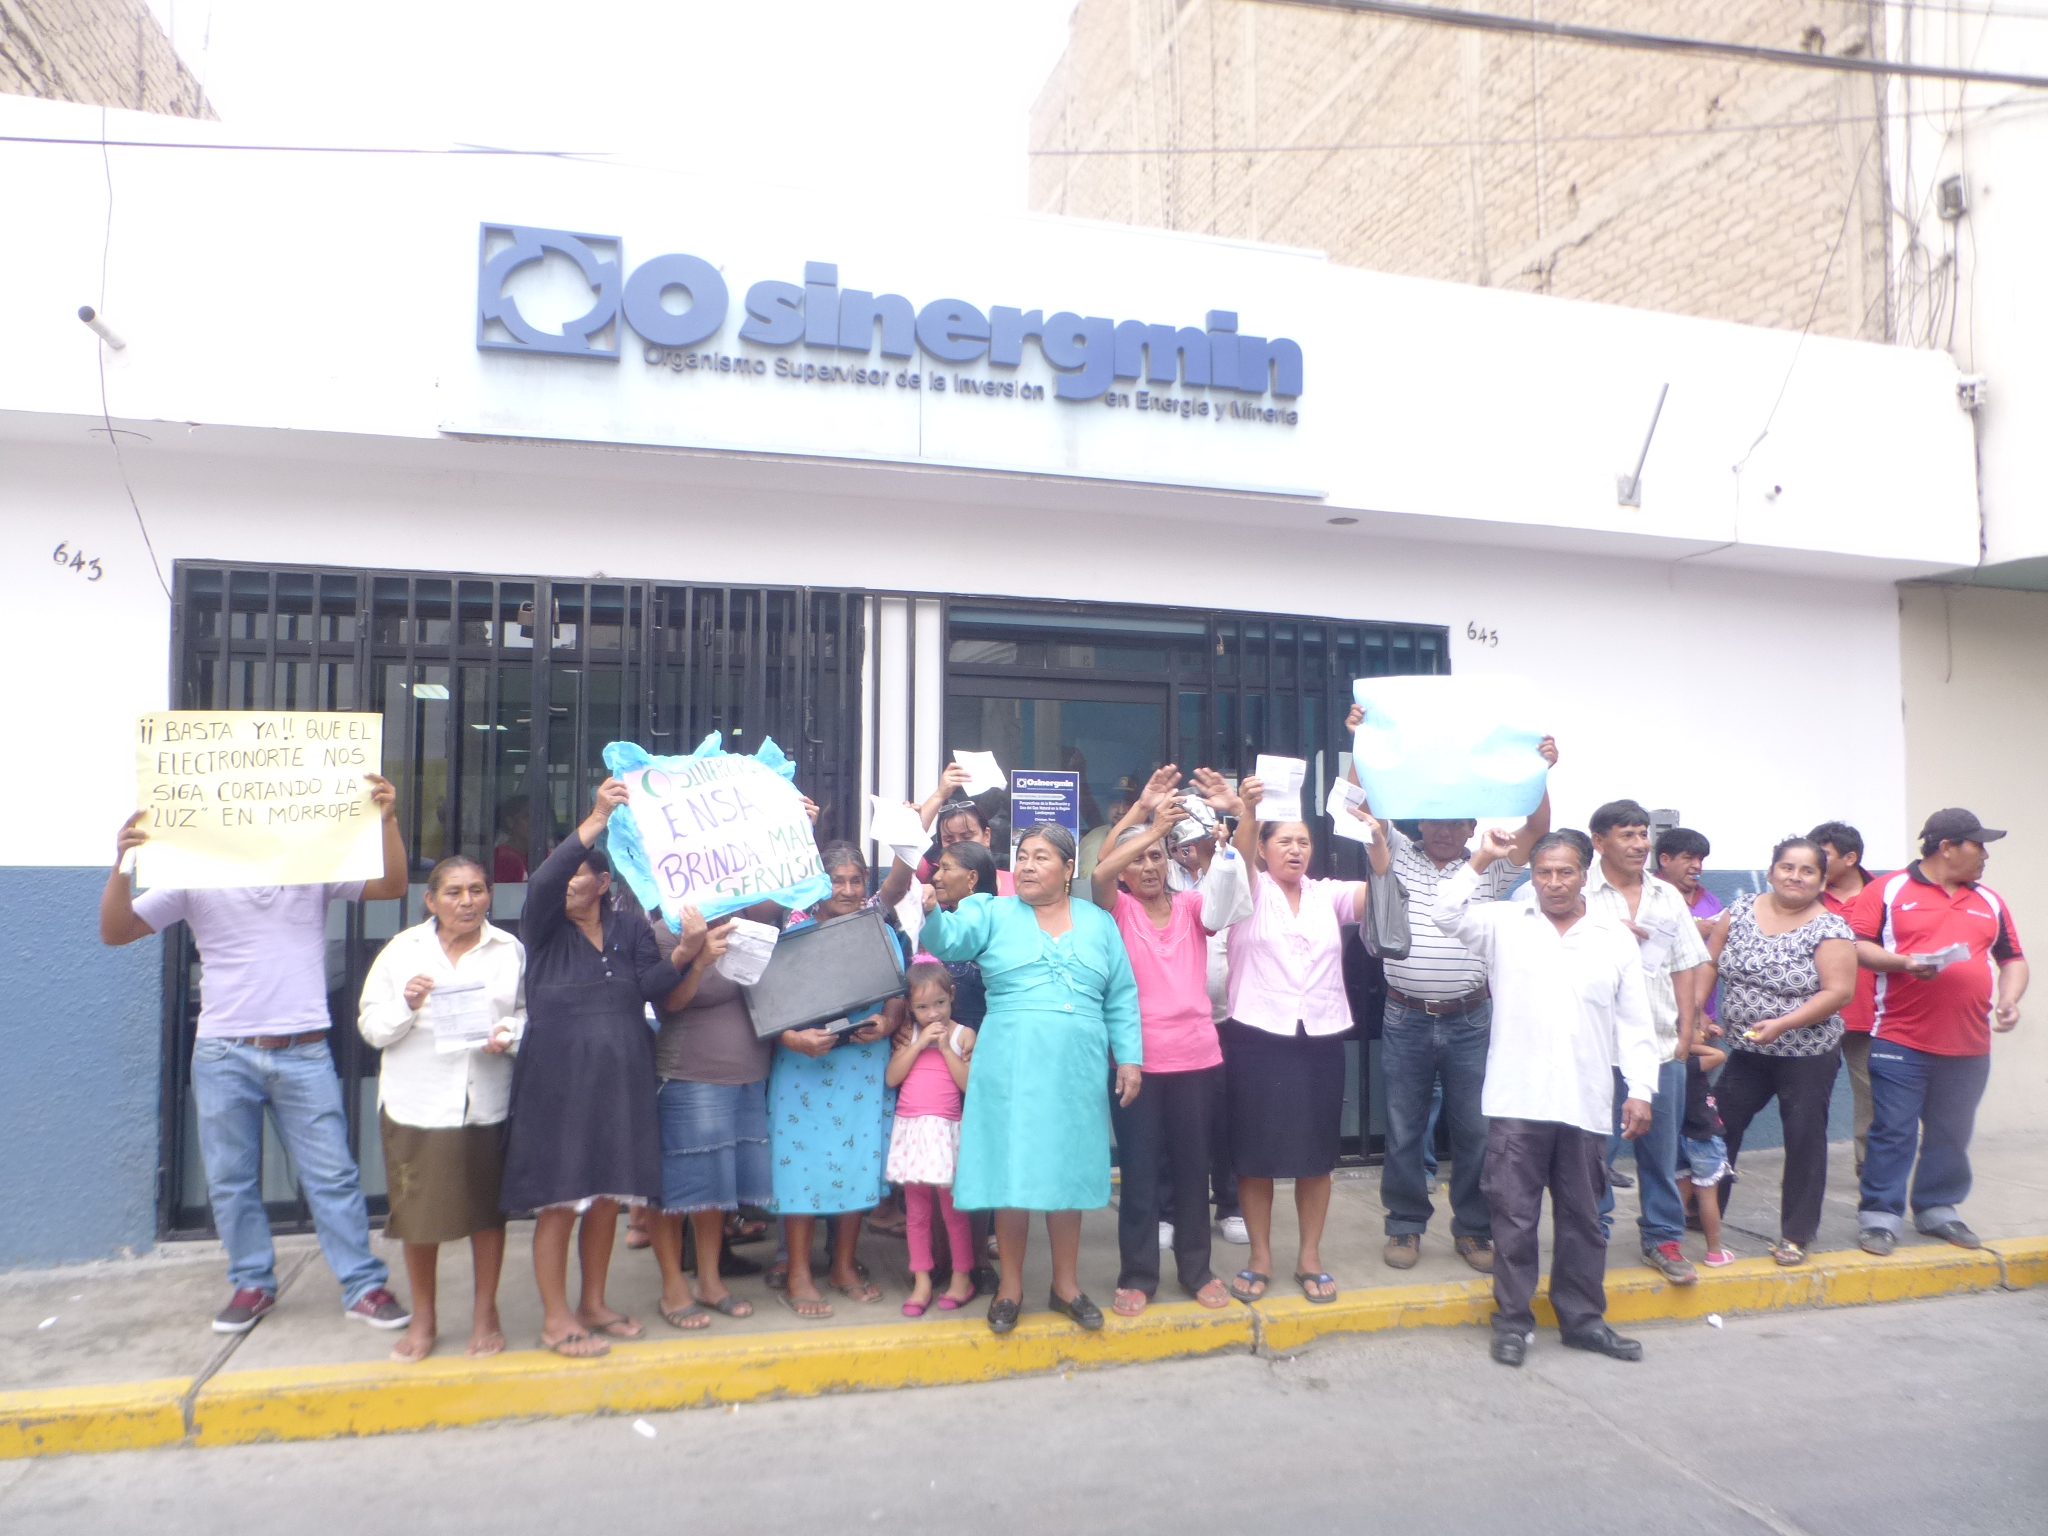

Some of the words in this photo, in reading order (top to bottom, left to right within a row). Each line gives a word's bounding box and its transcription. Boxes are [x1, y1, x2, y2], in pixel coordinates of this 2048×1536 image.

[622, 253, 1303, 400] Osinergmin
[644, 346, 767, 375] Organismo
[774, 357, 889, 386] Supervisor
[896, 368, 921, 389] de
[929, 371, 946, 391] la
[954, 373, 1045, 400] Inversión
[1105, 390, 1129, 408] en
[1214, 403, 1227, 421] y
[53, 540, 103, 582] 643
[1467, 620, 1498, 648] 645
[306, 718, 341, 740] QUE
[349, 720, 371, 740] EL
[158, 747, 305, 776] ELECTRONORTE
[323, 747, 365, 767] NOS
[217, 778, 323, 802] CORTANDO
[335, 778, 358, 795] LA
[1027, 779, 1073, 788] Osinergmin
[222, 807, 253, 826] EN
[268, 801, 362, 825] MORROPE
[661, 786, 764, 843] ENSA
[658, 842, 762, 899] BRINDA
[768, 820, 816, 858] MAL
